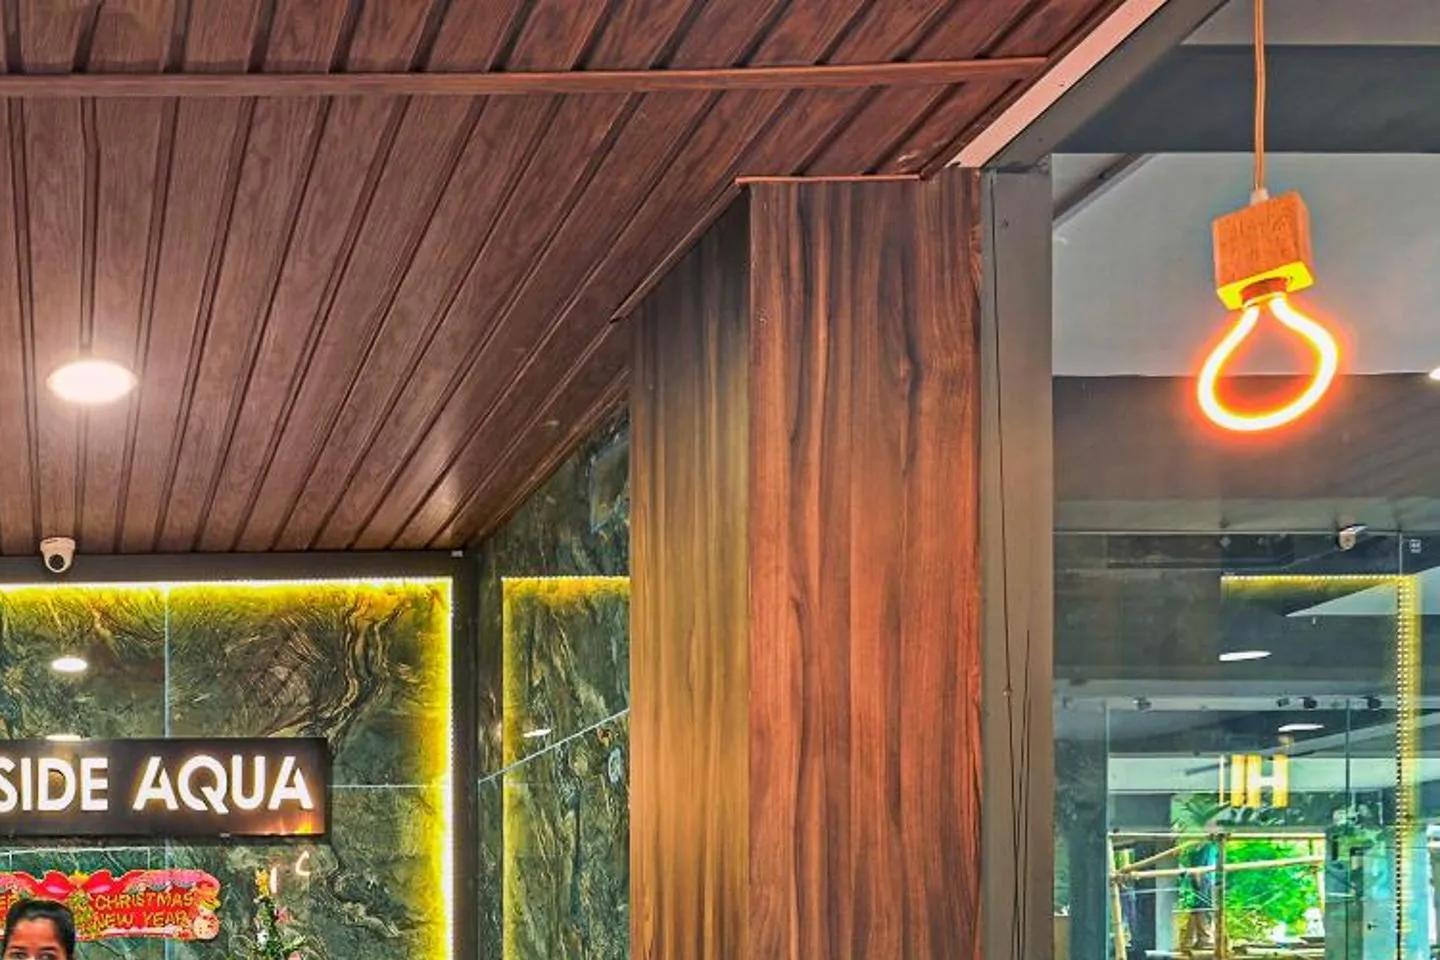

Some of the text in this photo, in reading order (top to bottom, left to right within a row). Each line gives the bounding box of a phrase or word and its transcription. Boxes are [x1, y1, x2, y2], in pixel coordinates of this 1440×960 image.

[132, 754, 315, 815] AQUA
[95, 892, 194, 911] CHRISTMAS
[143, 910, 189, 929] YEAR
